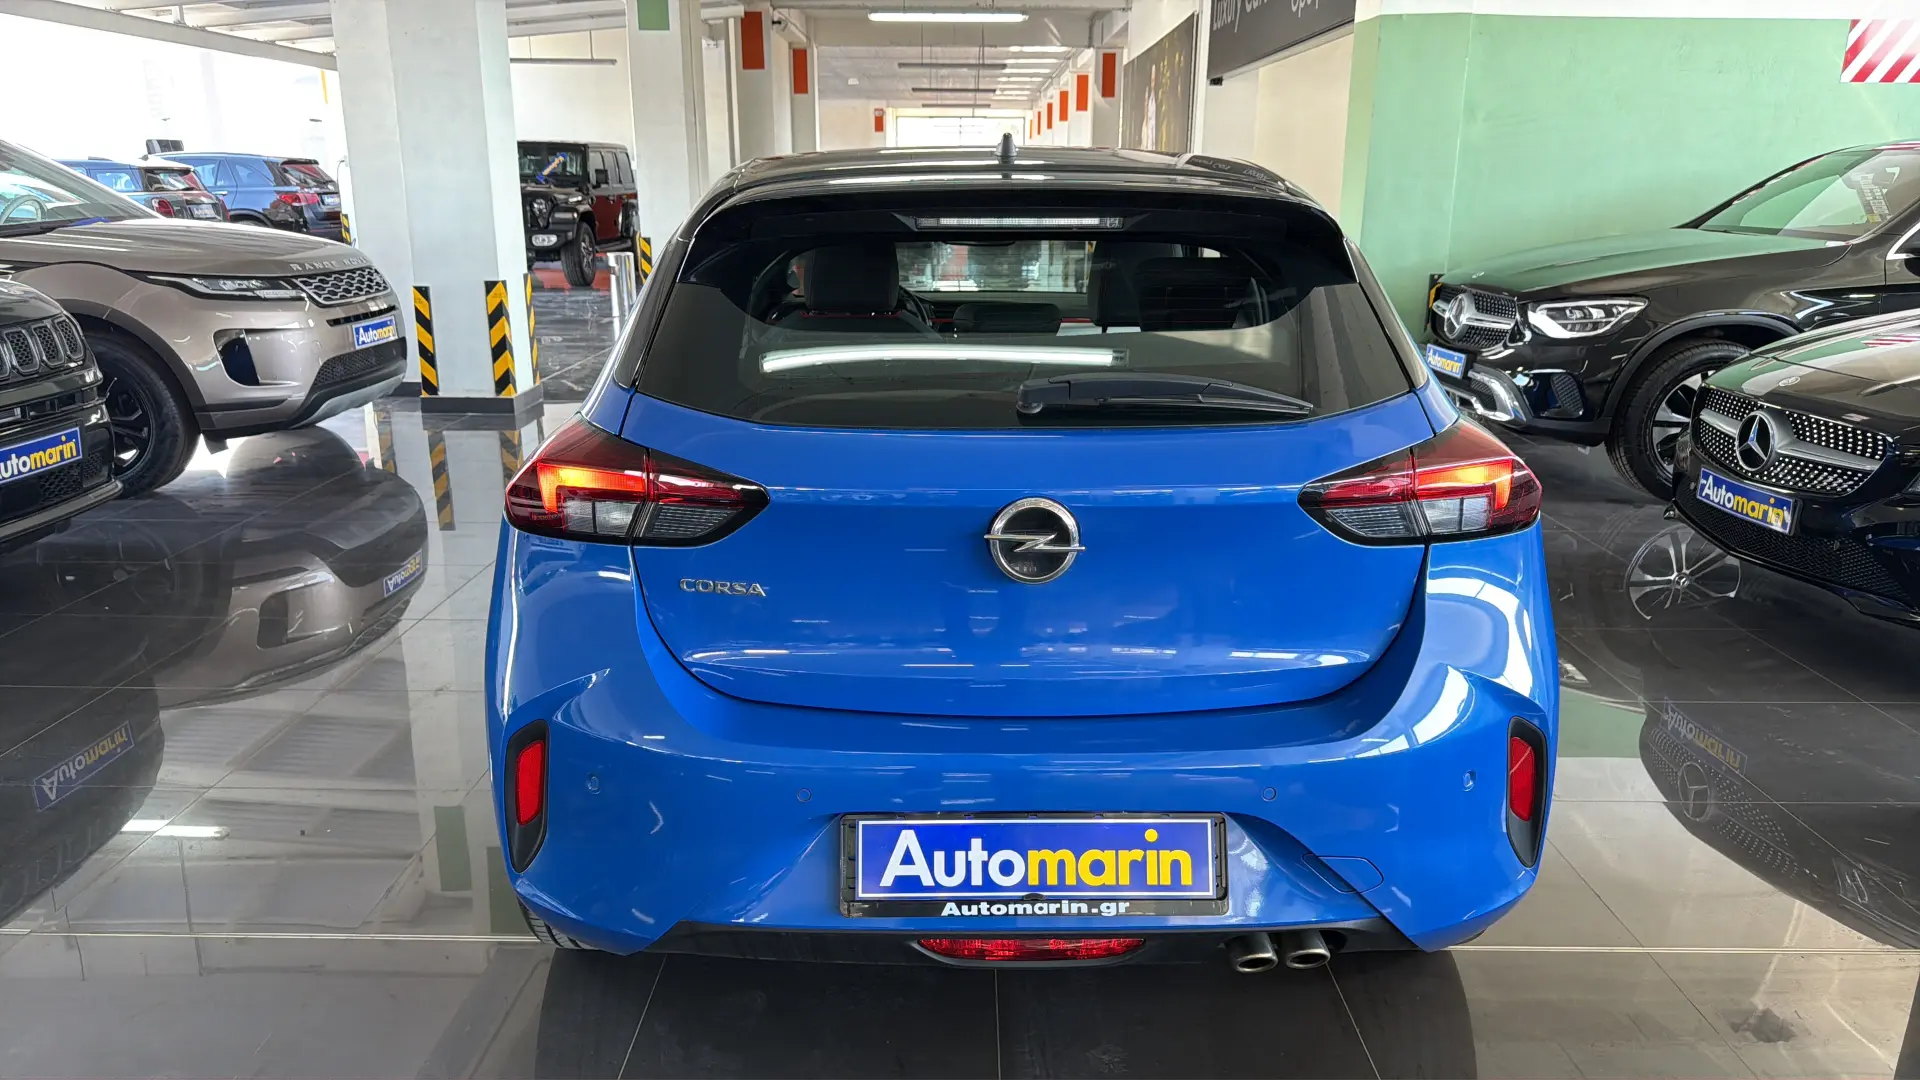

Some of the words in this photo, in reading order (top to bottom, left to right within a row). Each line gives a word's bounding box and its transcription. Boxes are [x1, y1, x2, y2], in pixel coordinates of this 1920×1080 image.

[289, 260, 340, 271] RANGE
[0, 435, 77, 479] utomarin
[1701, 475, 1785, 527] Automarin
[680, 578, 766, 597] CORSA
[879, 828, 1192, 887] Automarin
[941, 900, 1130, 917] Automarin.gr
